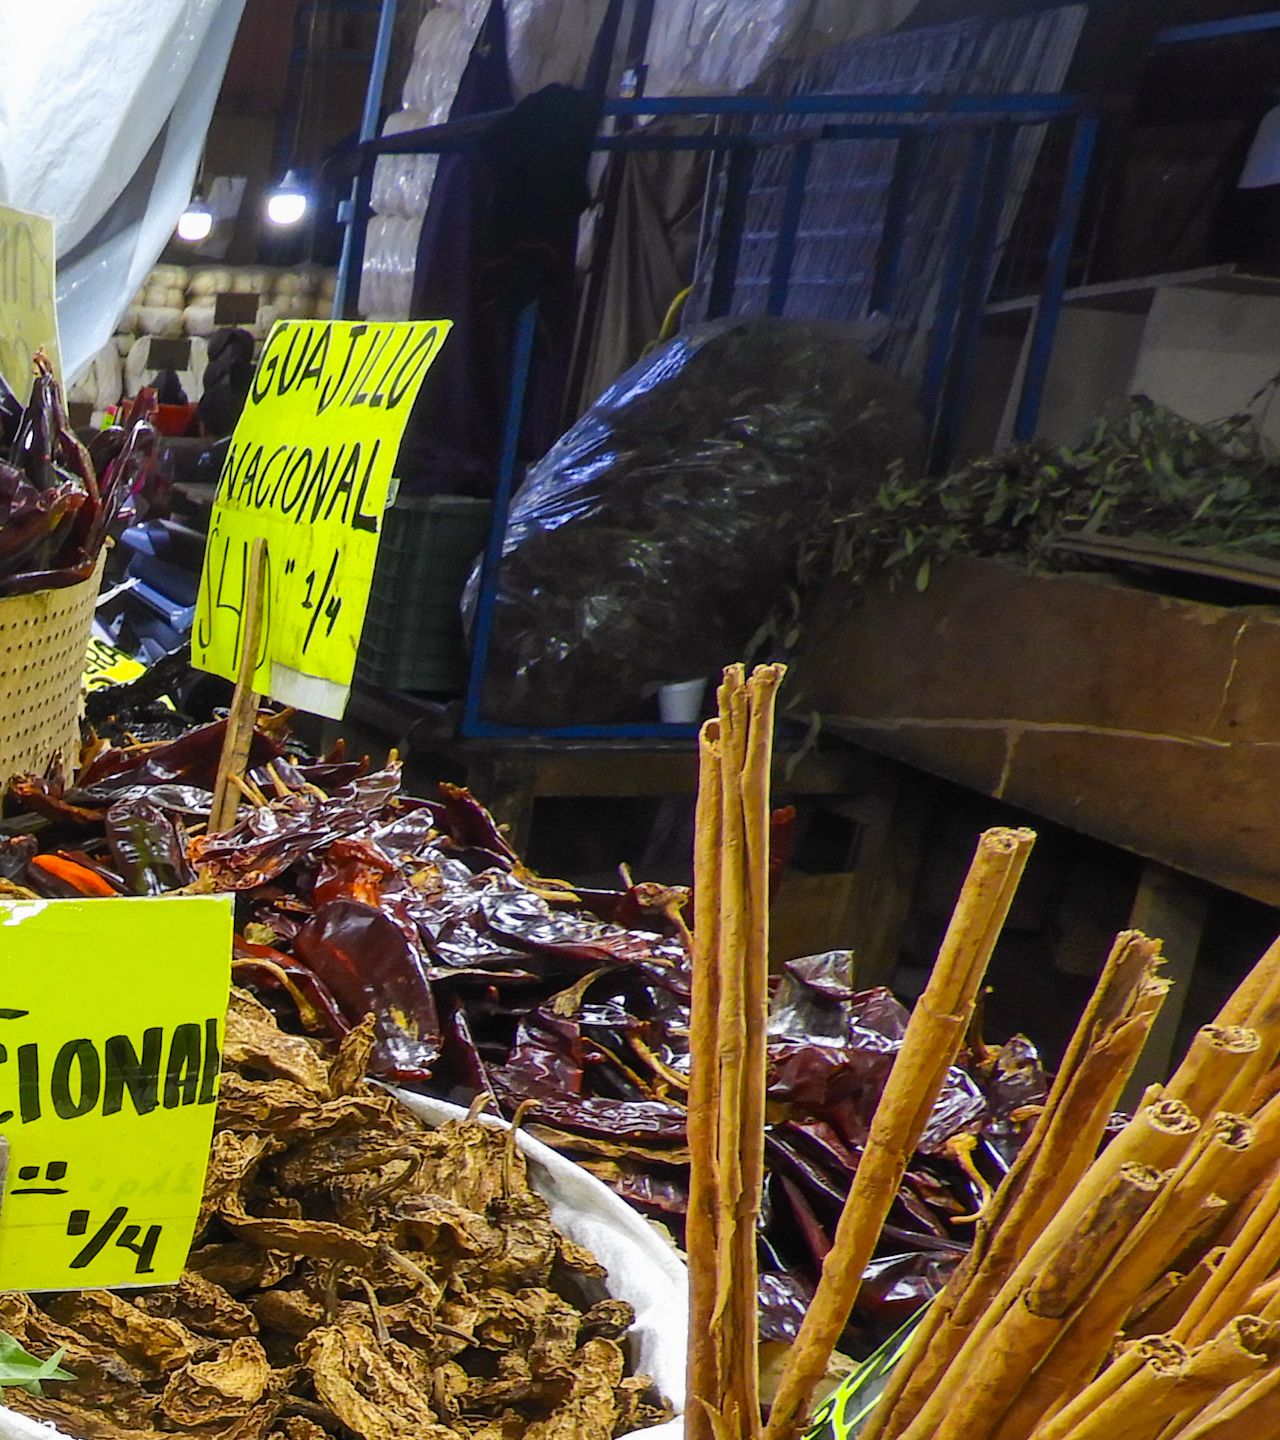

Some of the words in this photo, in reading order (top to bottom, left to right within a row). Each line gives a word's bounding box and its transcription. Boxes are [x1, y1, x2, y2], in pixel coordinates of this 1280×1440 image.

[251, 322, 438, 417] GUAJILLO
[215, 438, 381, 533] NACIONAL
[300, 547, 343, 656] 1/4
[66, 1205, 163, 1275] 1/4
